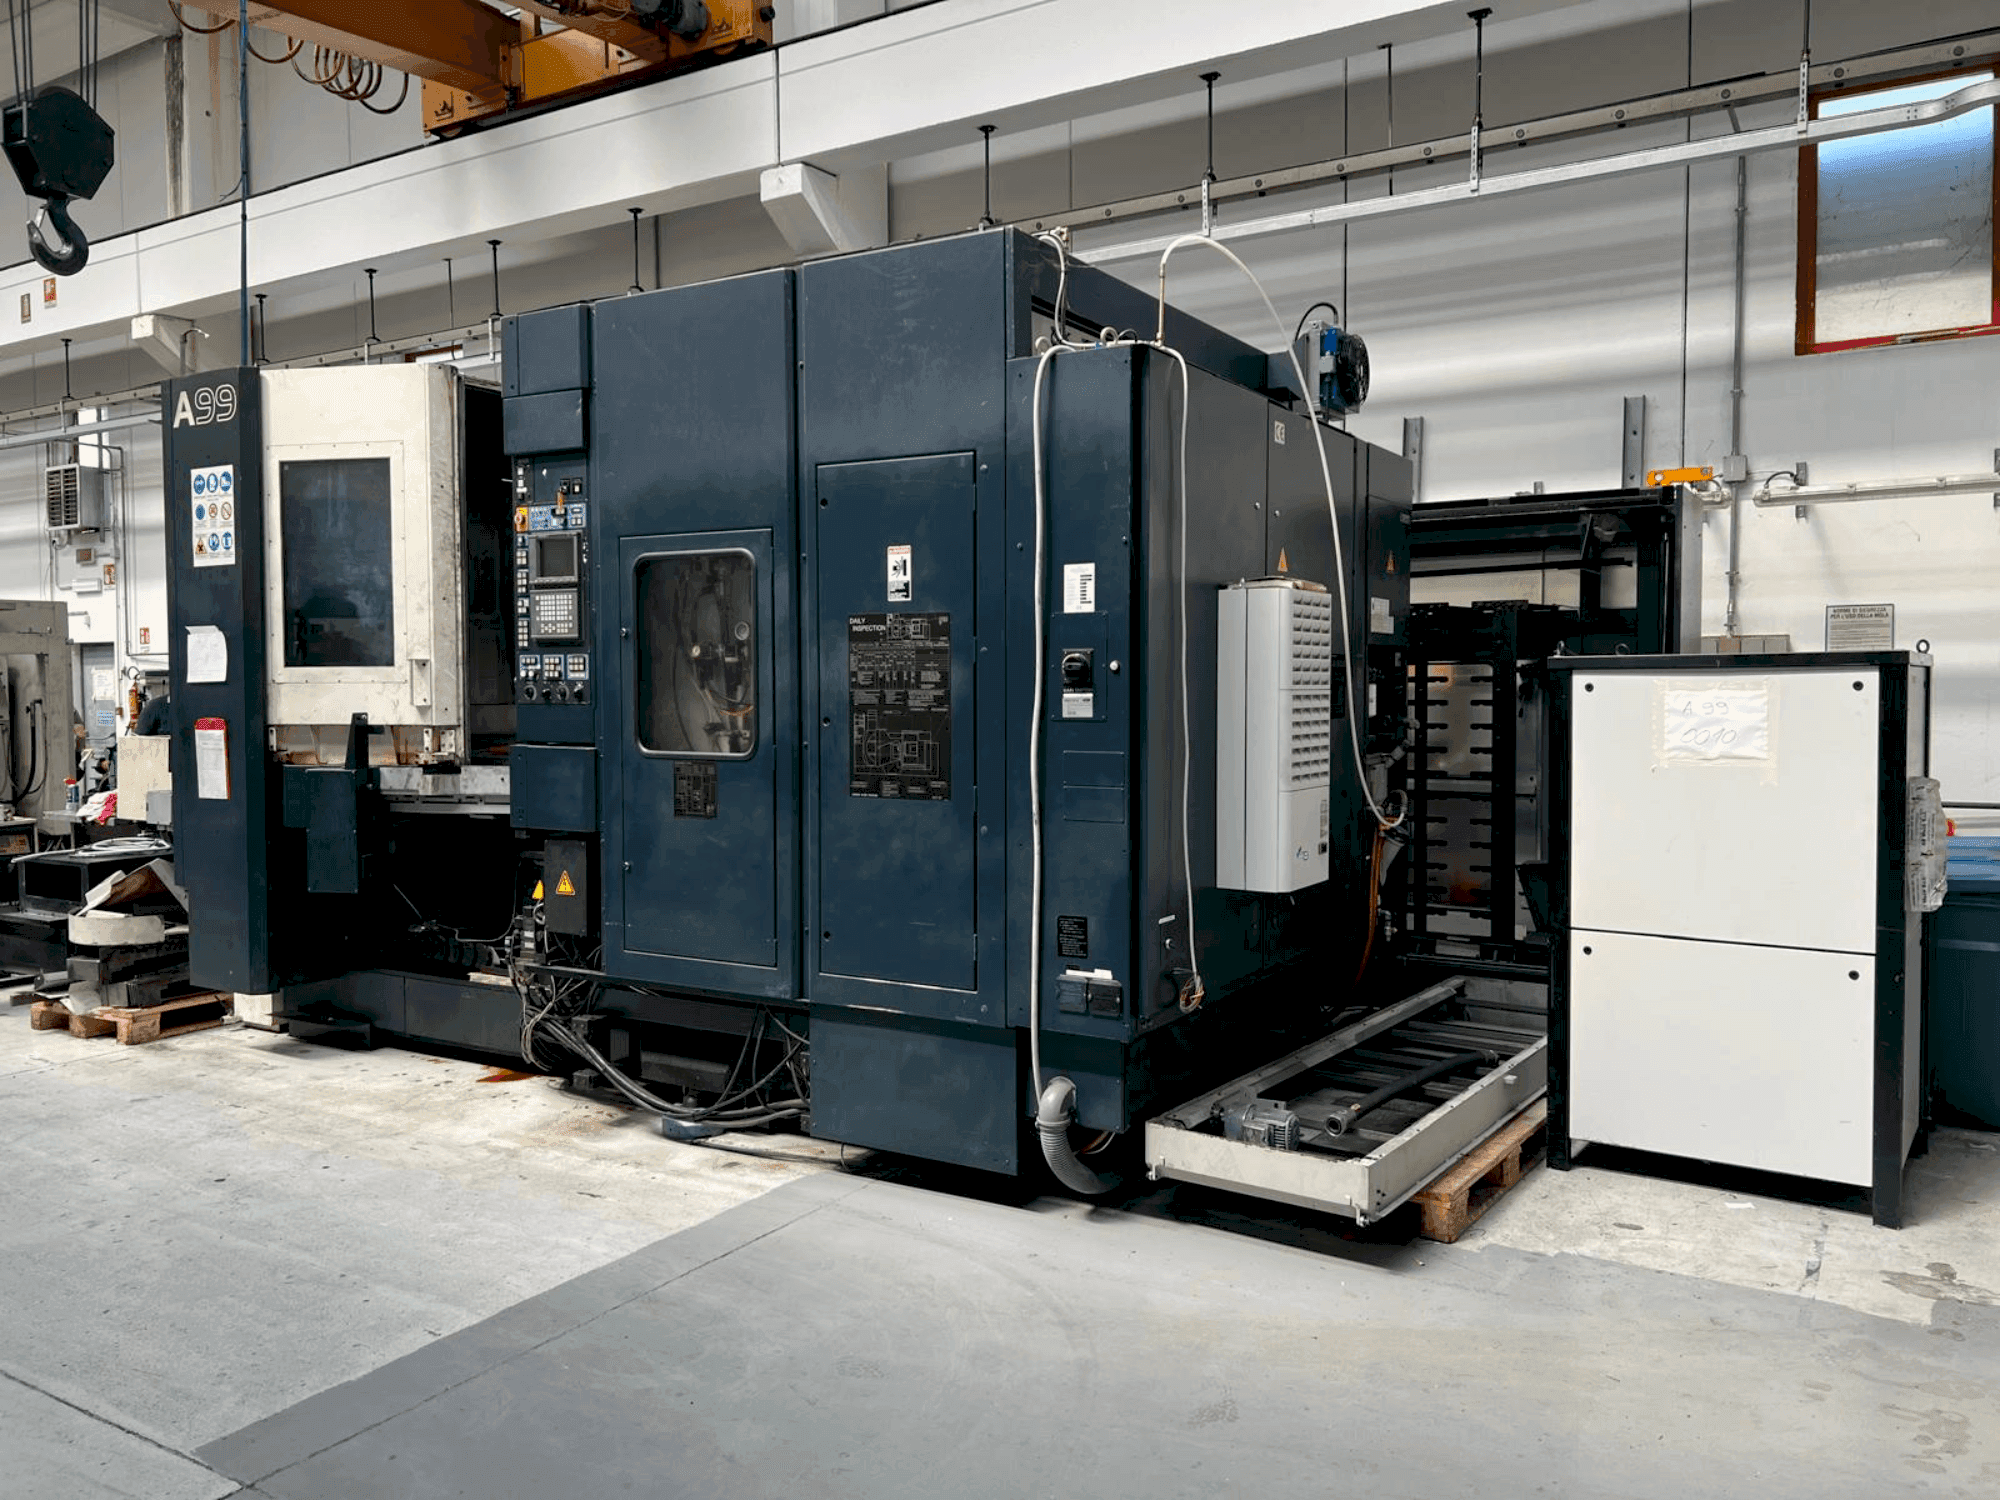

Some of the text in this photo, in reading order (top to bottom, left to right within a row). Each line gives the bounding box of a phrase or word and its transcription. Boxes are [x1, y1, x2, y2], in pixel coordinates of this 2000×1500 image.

[173, 383, 237, 429] A99
[849, 617, 866, 625] DAILY
[852, 624, 886, 632] INSPECTION
[1682, 700, 1730, 717] A 99
